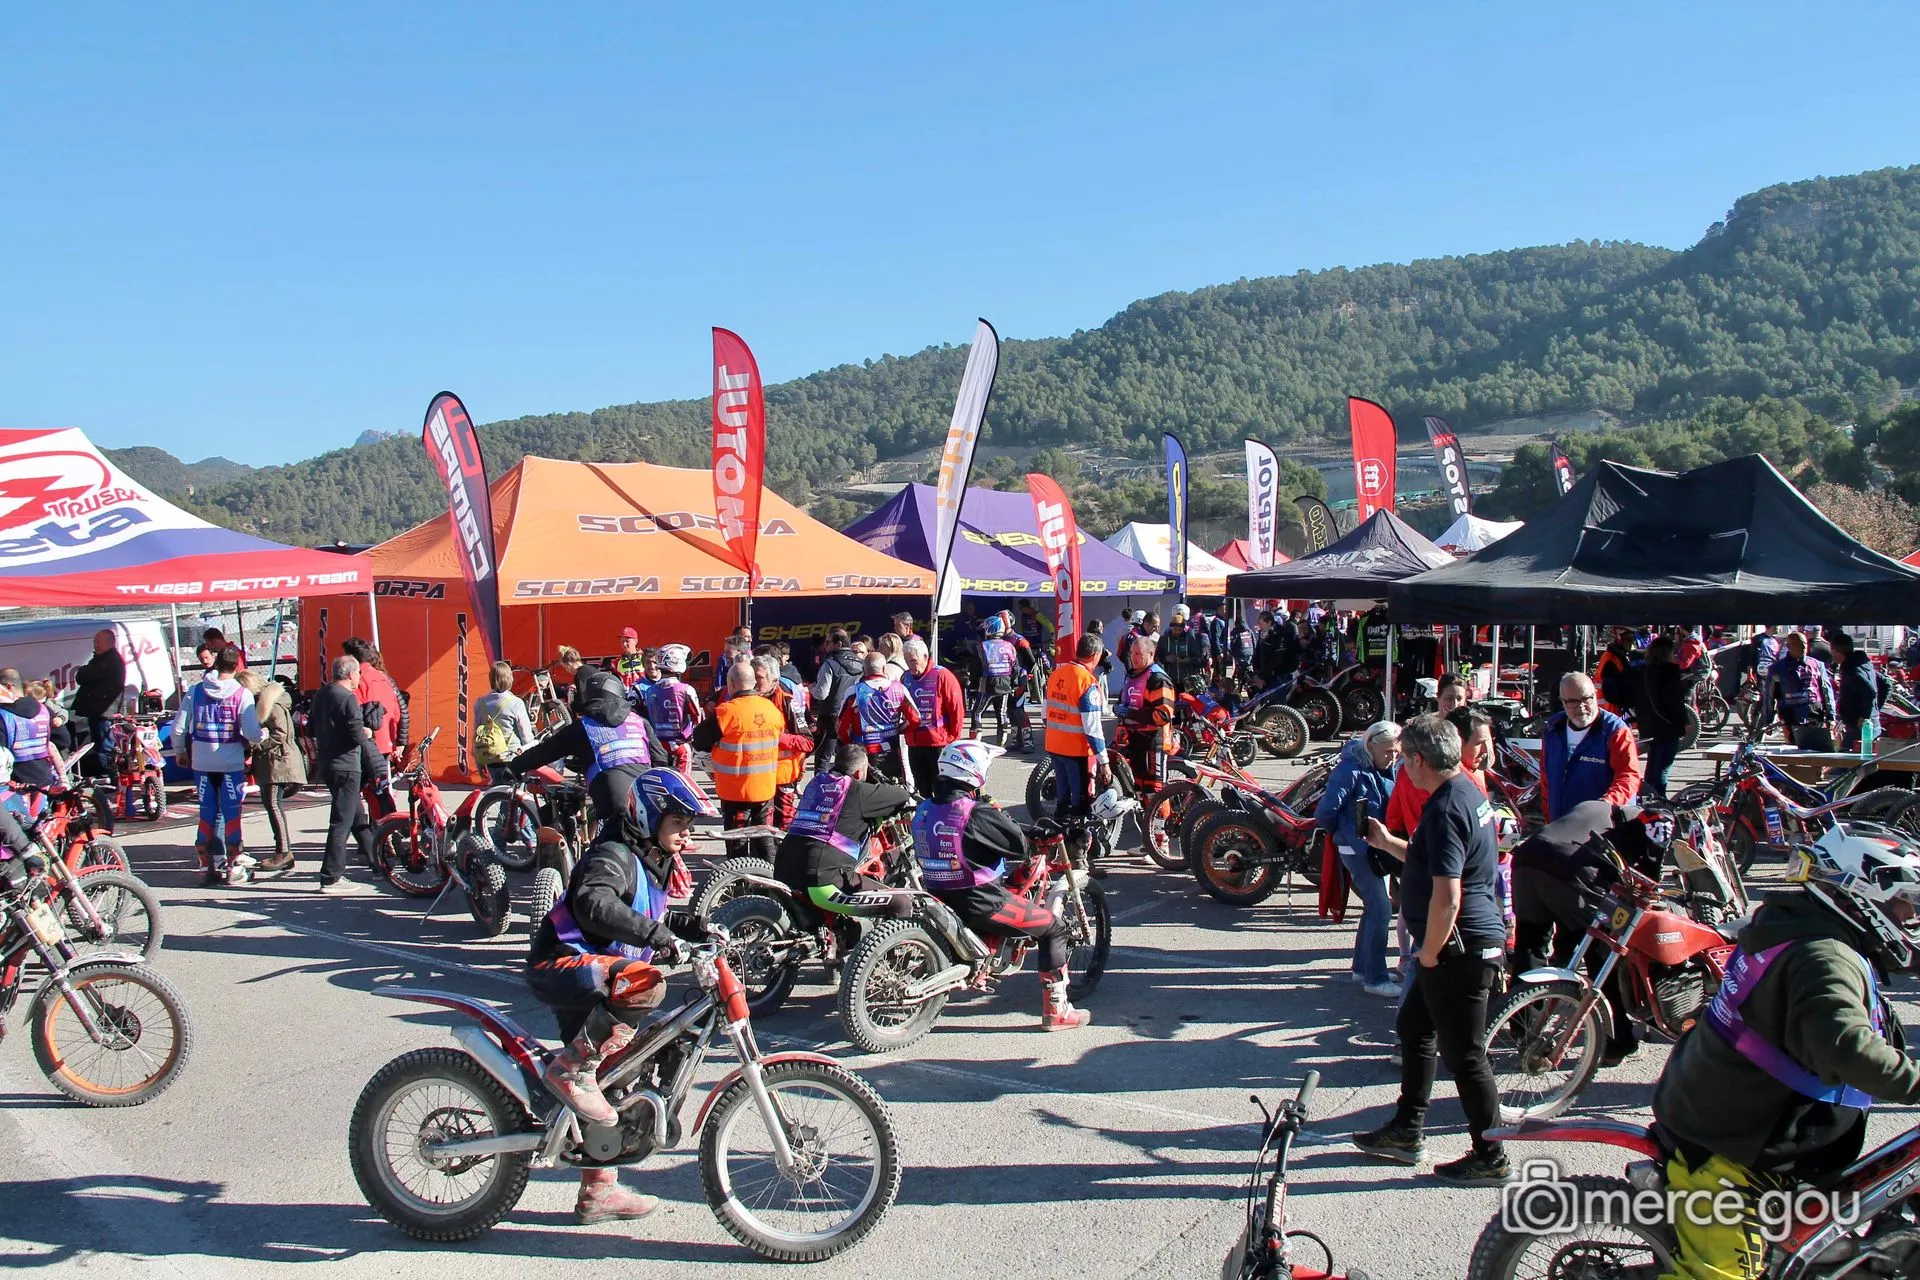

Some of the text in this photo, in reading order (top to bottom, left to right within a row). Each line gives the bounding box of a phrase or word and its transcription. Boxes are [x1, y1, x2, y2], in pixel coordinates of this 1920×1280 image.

[47, 487, 150, 519] TRUEBA
[0, 506, 153, 558] eta
[577, 511, 799, 536] SCORA
[960, 529, 1087, 548] SHERO
[366, 579, 446, 600] ORPA
[513, 575, 660, 599] SCORPA
[1117, 579, 1176, 591] SHERCO
[456, 612, 469, 777] SCORPA
